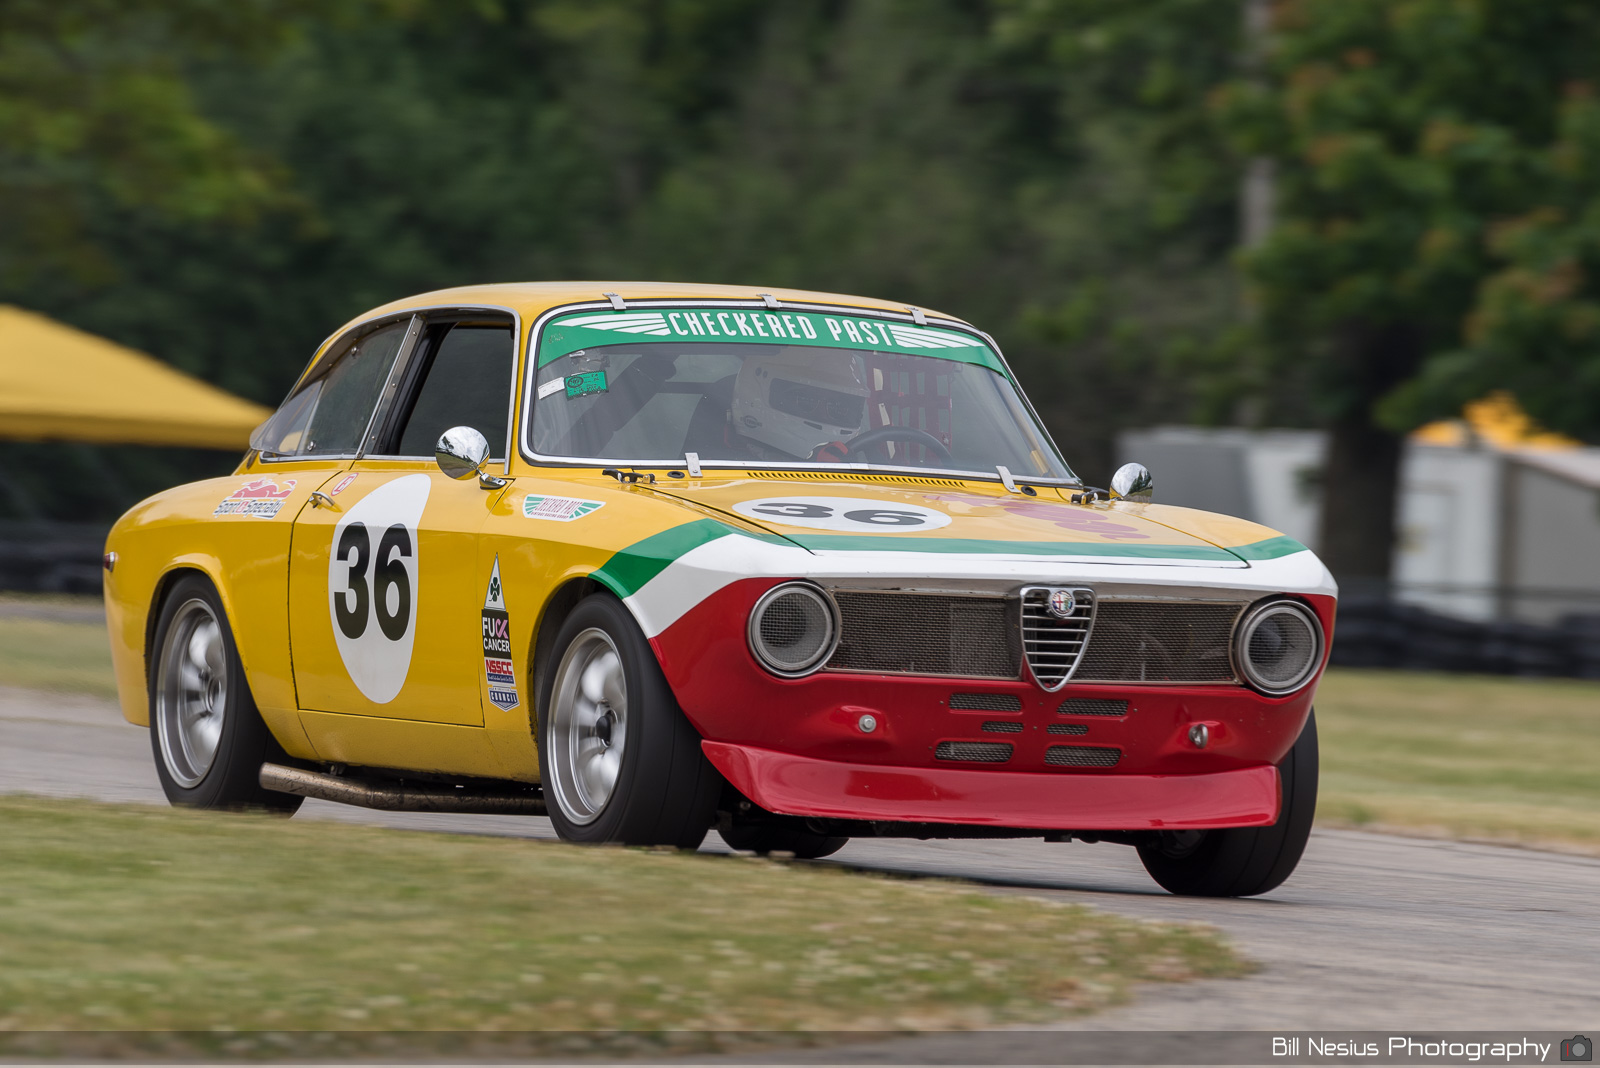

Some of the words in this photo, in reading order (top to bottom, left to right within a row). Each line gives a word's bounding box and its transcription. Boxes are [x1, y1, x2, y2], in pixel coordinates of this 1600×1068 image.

[668, 312, 817, 339] CHECKERED
[825, 317, 893, 346] PAST
[752, 503, 927, 525] 36
[334, 521, 412, 641] 36
[483, 637, 511, 652] CANCER
[486, 659, 513, 675] NSSCC
